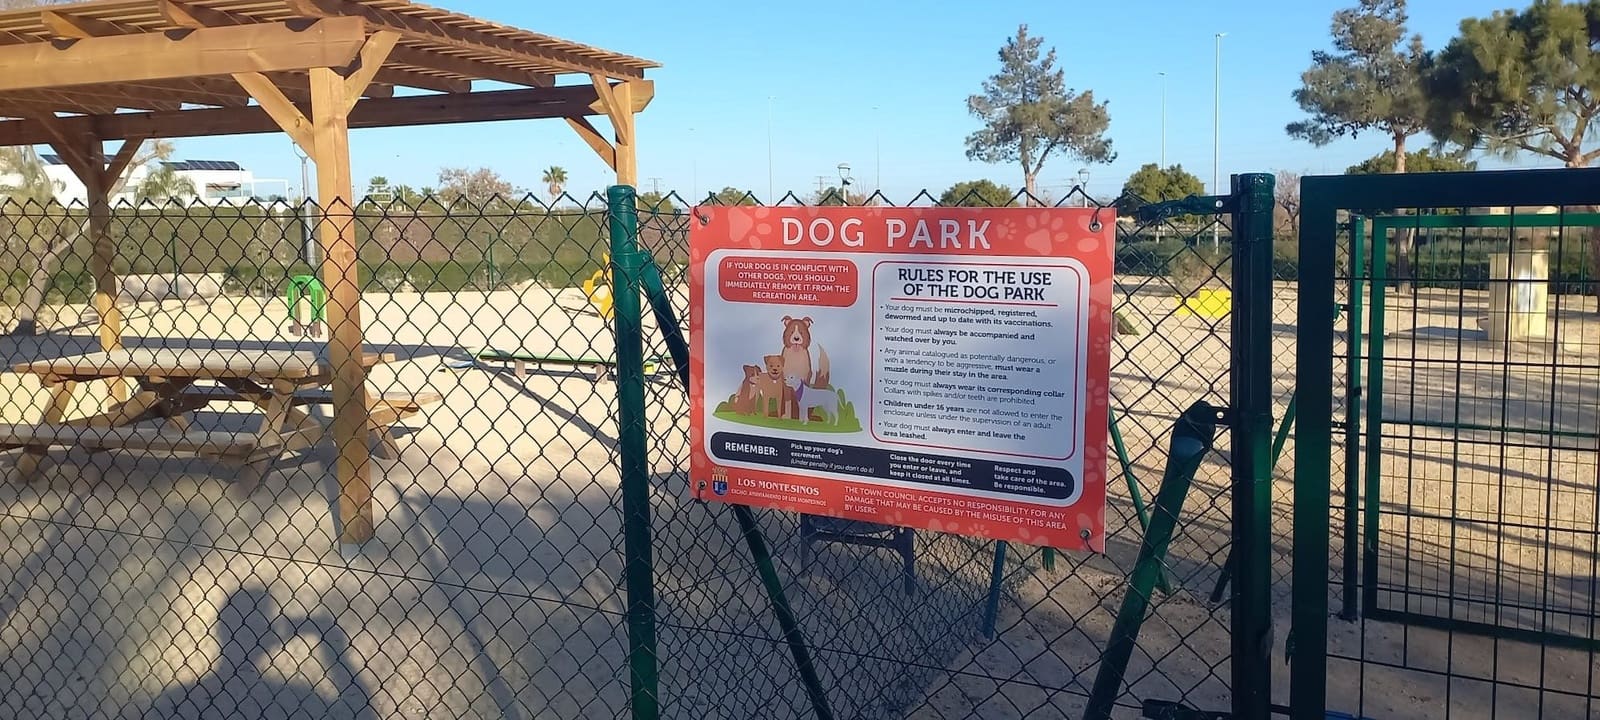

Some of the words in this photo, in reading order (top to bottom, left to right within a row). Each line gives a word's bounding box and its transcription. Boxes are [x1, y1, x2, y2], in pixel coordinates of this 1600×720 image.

[781, 217, 866, 246] DOG
[885, 218, 991, 249] PARK
[763, 273, 786, 281] DOGS,
[804, 274, 835, 282] SHOULD
[898, 268, 943, 282] RULES
[946, 269, 979, 283] FOR
[981, 270, 1016, 284] THE
[1019, 272, 1052, 286] USE
[725, 281, 770, 289] IMMEDIATELY
[812, 284, 833, 292] FROM
[903, 283, 923, 295] OF
[926, 284, 960, 297] THE
[963, 285, 999, 298] DOG
[1003, 286, 1045, 300] PARK
[752, 291, 796, 300] RECREATION
[798, 293, 819, 301] AREA.
[900, 304, 914, 312] dog
[884, 312, 921, 320] dewormed
[884, 334, 913, 342] watched
[931, 337, 940, 345] by
[900, 326, 913, 334] dog
[933, 328, 957, 337] always
[969, 330, 1019, 340] accompanied
[909, 367, 933, 376] during
[952, 370, 967, 378] stay
[899, 379, 913, 387] dog
[932, 381, 956, 390] always
[987, 385, 1041, 397] corresponding
[883, 399, 912, 407] Children
[913, 401, 934, 409] under
[945, 405, 964, 413] years
[991, 408, 1019, 416] allowed
[1029, 411, 1048, 419] enter
[899, 422, 912, 431] dog
[931, 425, 955, 435] always
[977, 429, 991, 437] and
[992, 431, 1011, 439] leave
[724, 441, 778, 456] REMEMBER:
[790, 442, 803, 450] Pick
[826, 446, 843, 455] dog's
[889, 453, 907, 461] Close
[919, 456, 935, 464] door
[936, 459, 955, 467] every
[956, 460, 971, 468] time
[889, 462, 901, 470] you
[949, 467, 962, 475] and
[889, 469, 904, 478] keep
[911, 471, 932, 480] closed
[993, 464, 1021, 475] Respect
[1022, 467, 1036, 475] and
[993, 473, 1009, 481] take
[1035, 477, 1047, 485] the
[737, 477, 755, 487] LOS
[757, 480, 819, 495] MONTESINOS
[844, 485, 858, 494] THE
[859, 487, 882, 497] TOWN
[883, 490, 917, 501] COUNCIL
[918, 494, 951, 506] ACCEPTS
[952, 498, 965, 507] NO
[966, 500, 1029, 515] RESPONSIBILITY
[1030, 508, 1046, 517] FOR
[1048, 510, 1065, 520] ANY
[844, 495, 875, 505] DAMAGE
[876, 498, 894, 508] THAT
[895, 501, 911, 510] MAY
[912, 503, 921, 511] BE
[923, 504, 953, 515] CAUSED
[954, 508, 963, 516] BY
[964, 509, 981, 519] THE
[982, 512, 1011, 522] MISUSE
[1012, 515, 1023, 524] OF
[1024, 517, 1043, 527] THIS
[1045, 519, 1067, 530] AREA
